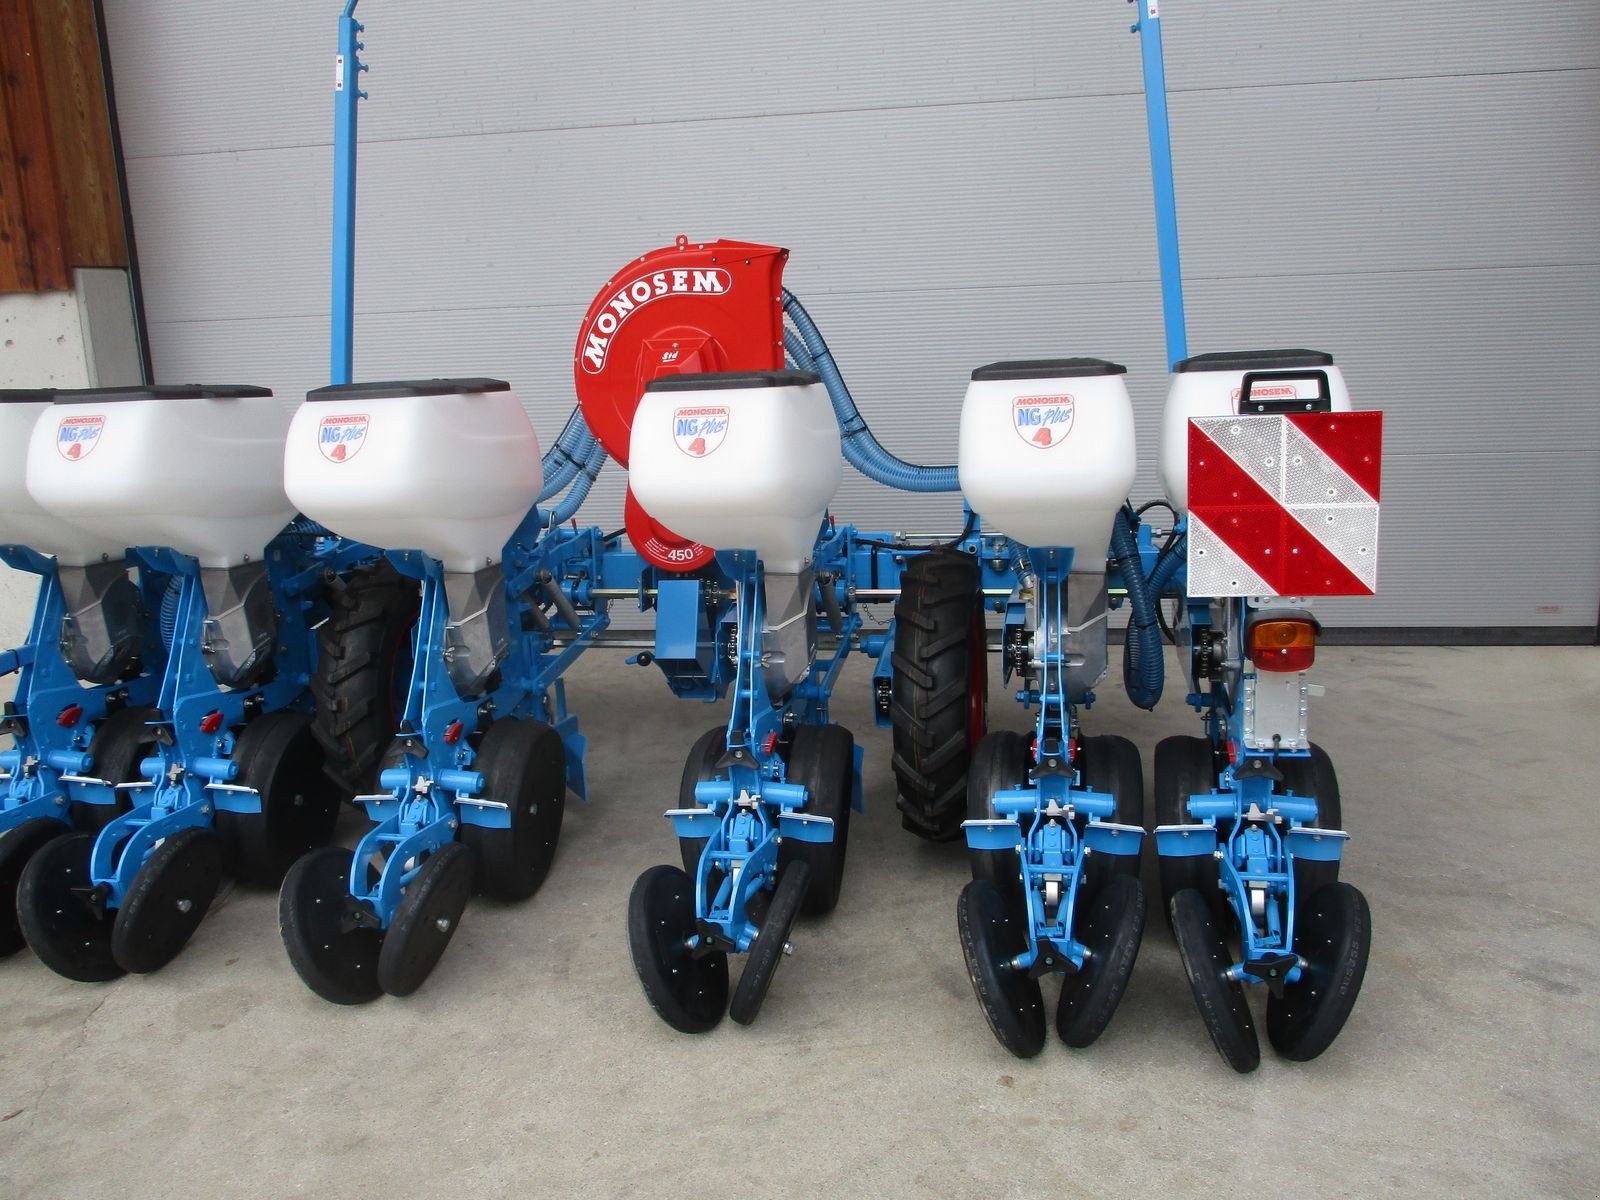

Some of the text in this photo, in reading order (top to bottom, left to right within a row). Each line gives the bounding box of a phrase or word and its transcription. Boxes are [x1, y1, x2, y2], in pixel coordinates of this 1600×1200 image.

[585, 271, 723, 368] MONOSEM
[662, 351, 679, 361] Std
[1016, 396, 1071, 405] MONOSEM
[323, 416, 367, 424] MONOSEM
[677, 408, 726, 416] MONOSEM
[1018, 408, 1041, 426] NG
[60, 427, 79, 441] NG
[321, 426, 341, 442] NG
[676, 419, 698, 436] NG
[1032, 427, 1052, 445] 4
[67, 442, 81, 458] 4
[331, 444, 346, 460] 4
[688, 437, 705, 455] 4
[668, 548, 693, 561] 450
